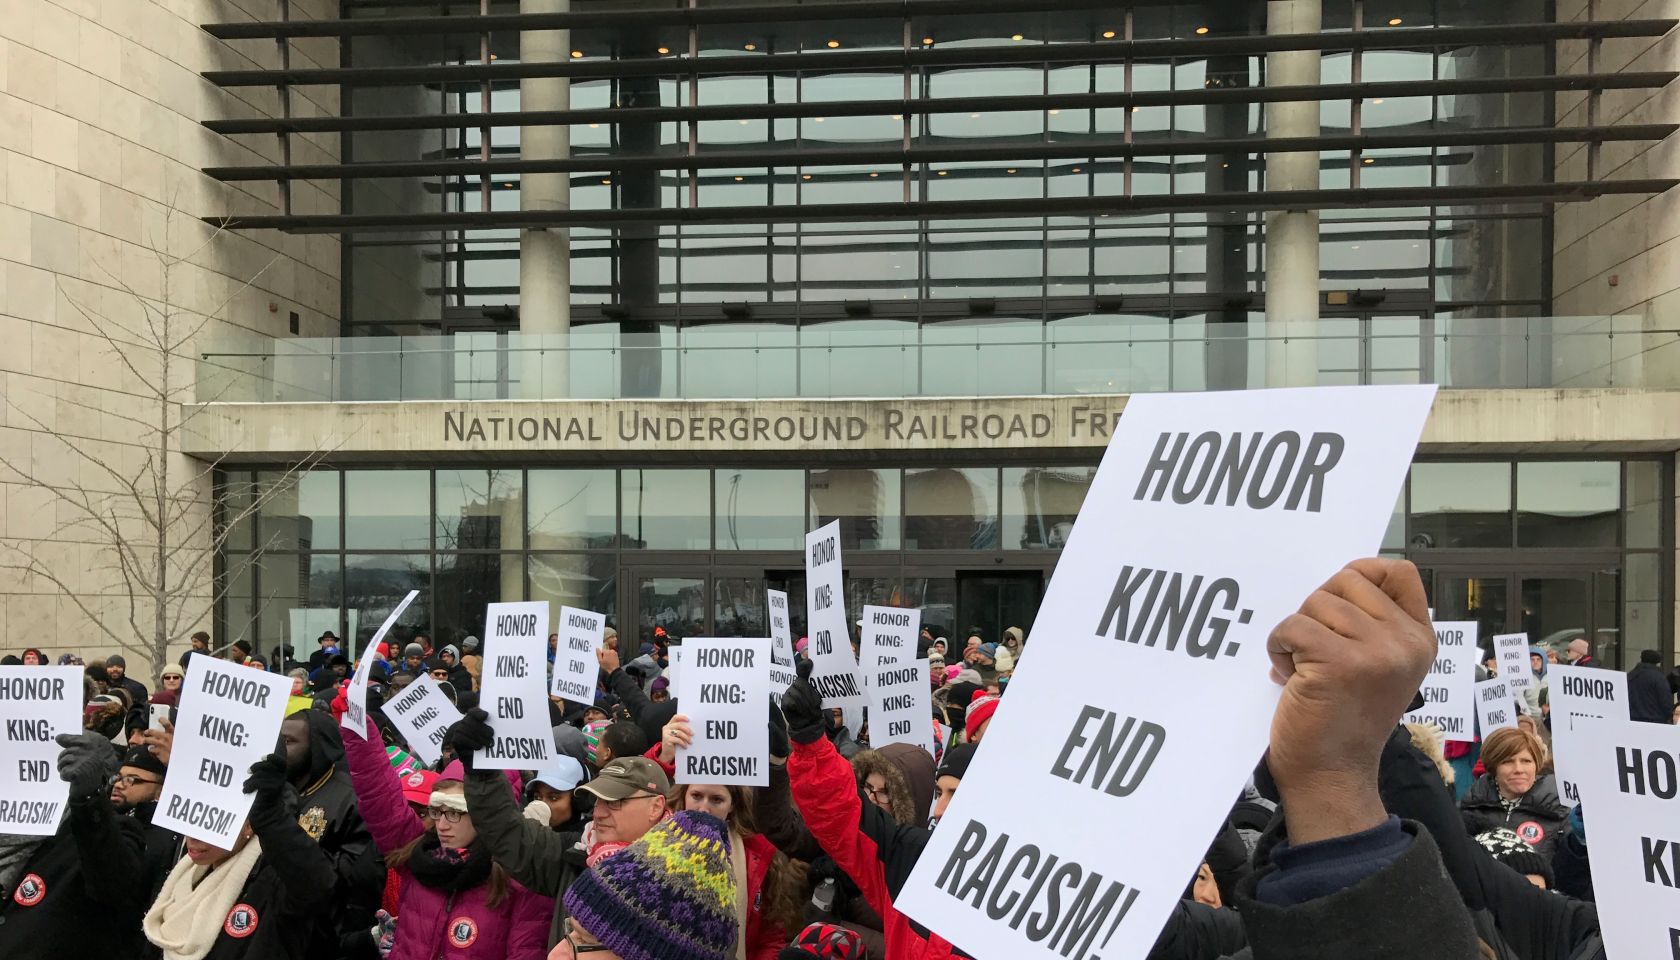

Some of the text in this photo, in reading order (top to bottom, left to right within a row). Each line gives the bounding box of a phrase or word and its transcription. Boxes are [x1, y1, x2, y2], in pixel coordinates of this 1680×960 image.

[444, 411, 602, 441] NATIONAL
[618, 409, 866, 442] UNDERGROUND
[884, 407, 1051, 441] RAILROAD
[1133, 431, 1344, 512] HONOR
[813, 537, 835, 568] HONOR
[815, 584, 832, 611] KING:
[568, 614, 598, 632] HONOR
[873, 613, 909, 626] HONOR
[1096, 566, 1253, 660] KING:
[497, 614, 537, 636] HONOR
[568, 637, 592, 652] KING:
[817, 630, 832, 655] END
[875, 634, 903, 647] KING:
[1436, 630, 1464, 646] NOR
[1500, 638, 1522, 647] HONOR
[496, 656, 528, 678] KING:
[569, 660, 584, 674] END
[697, 648, 754, 667] HONOR
[878, 668, 918, 687] HONOR
[1507, 665, 1520, 674] END
[0, 678, 64, 700] HONOR
[202, 670, 270, 708] HONOR
[557, 679, 590, 699] RACISM!
[1482, 684, 1506, 701] HONOR
[1510, 677, 1530, 688] CISM!
[1563, 676, 1614, 701] HONOR
[393, 684, 430, 715] HONOR
[700, 684, 745, 704] KING:
[883, 695, 914, 712] KING:
[1425, 687, 1448, 703] END
[411, 706, 440, 730] KING:
[498, 697, 523, 719] END
[1488, 709, 1507, 725] KING:
[7, 720, 54, 741] KING:
[200, 714, 249, 747] KING:
[706, 720, 737, 740] END
[889, 720, 910, 736] END
[1050, 705, 1166, 797] END
[19, 760, 49, 782] END
[199, 758, 233, 787] END
[686, 755, 757, 777] RACISM!
[0, 800, 58, 825] RACISM!
[166, 794, 236, 836] RACISM!
[934, 818, 1140, 960] RACISM!
